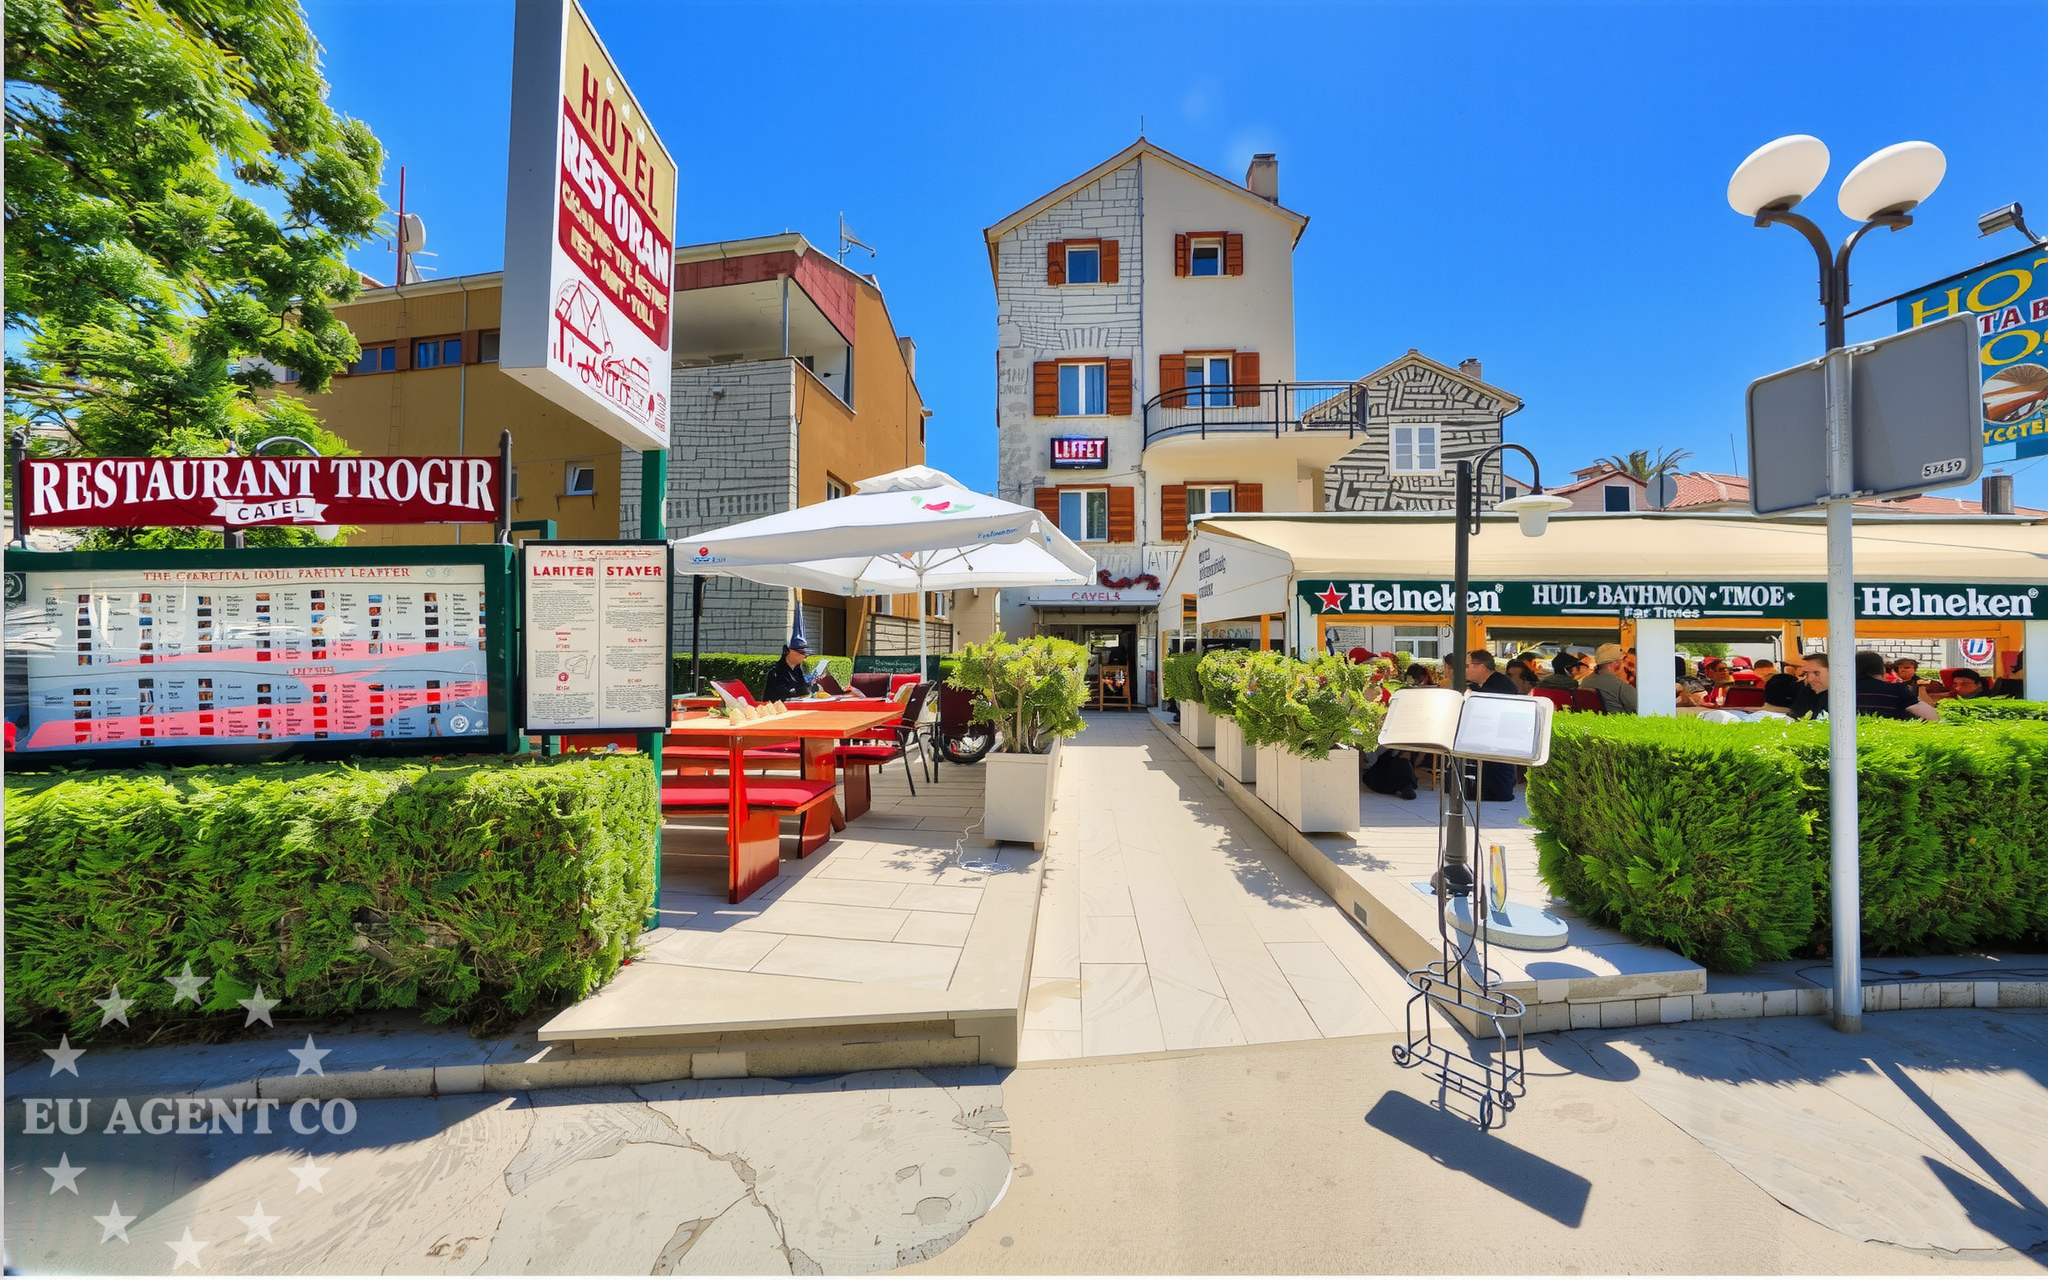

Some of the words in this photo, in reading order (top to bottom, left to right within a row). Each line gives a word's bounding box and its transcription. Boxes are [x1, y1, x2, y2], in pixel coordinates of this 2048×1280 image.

[582, 63, 658, 219] HOTEL
[563, 115, 669, 288] RESTORAN
[29, 458, 320, 516] RESTAURANT
[330, 458, 495, 511] TROGIR
[237, 500, 305, 521] CATEL
[143, 571, 171, 581] THE
